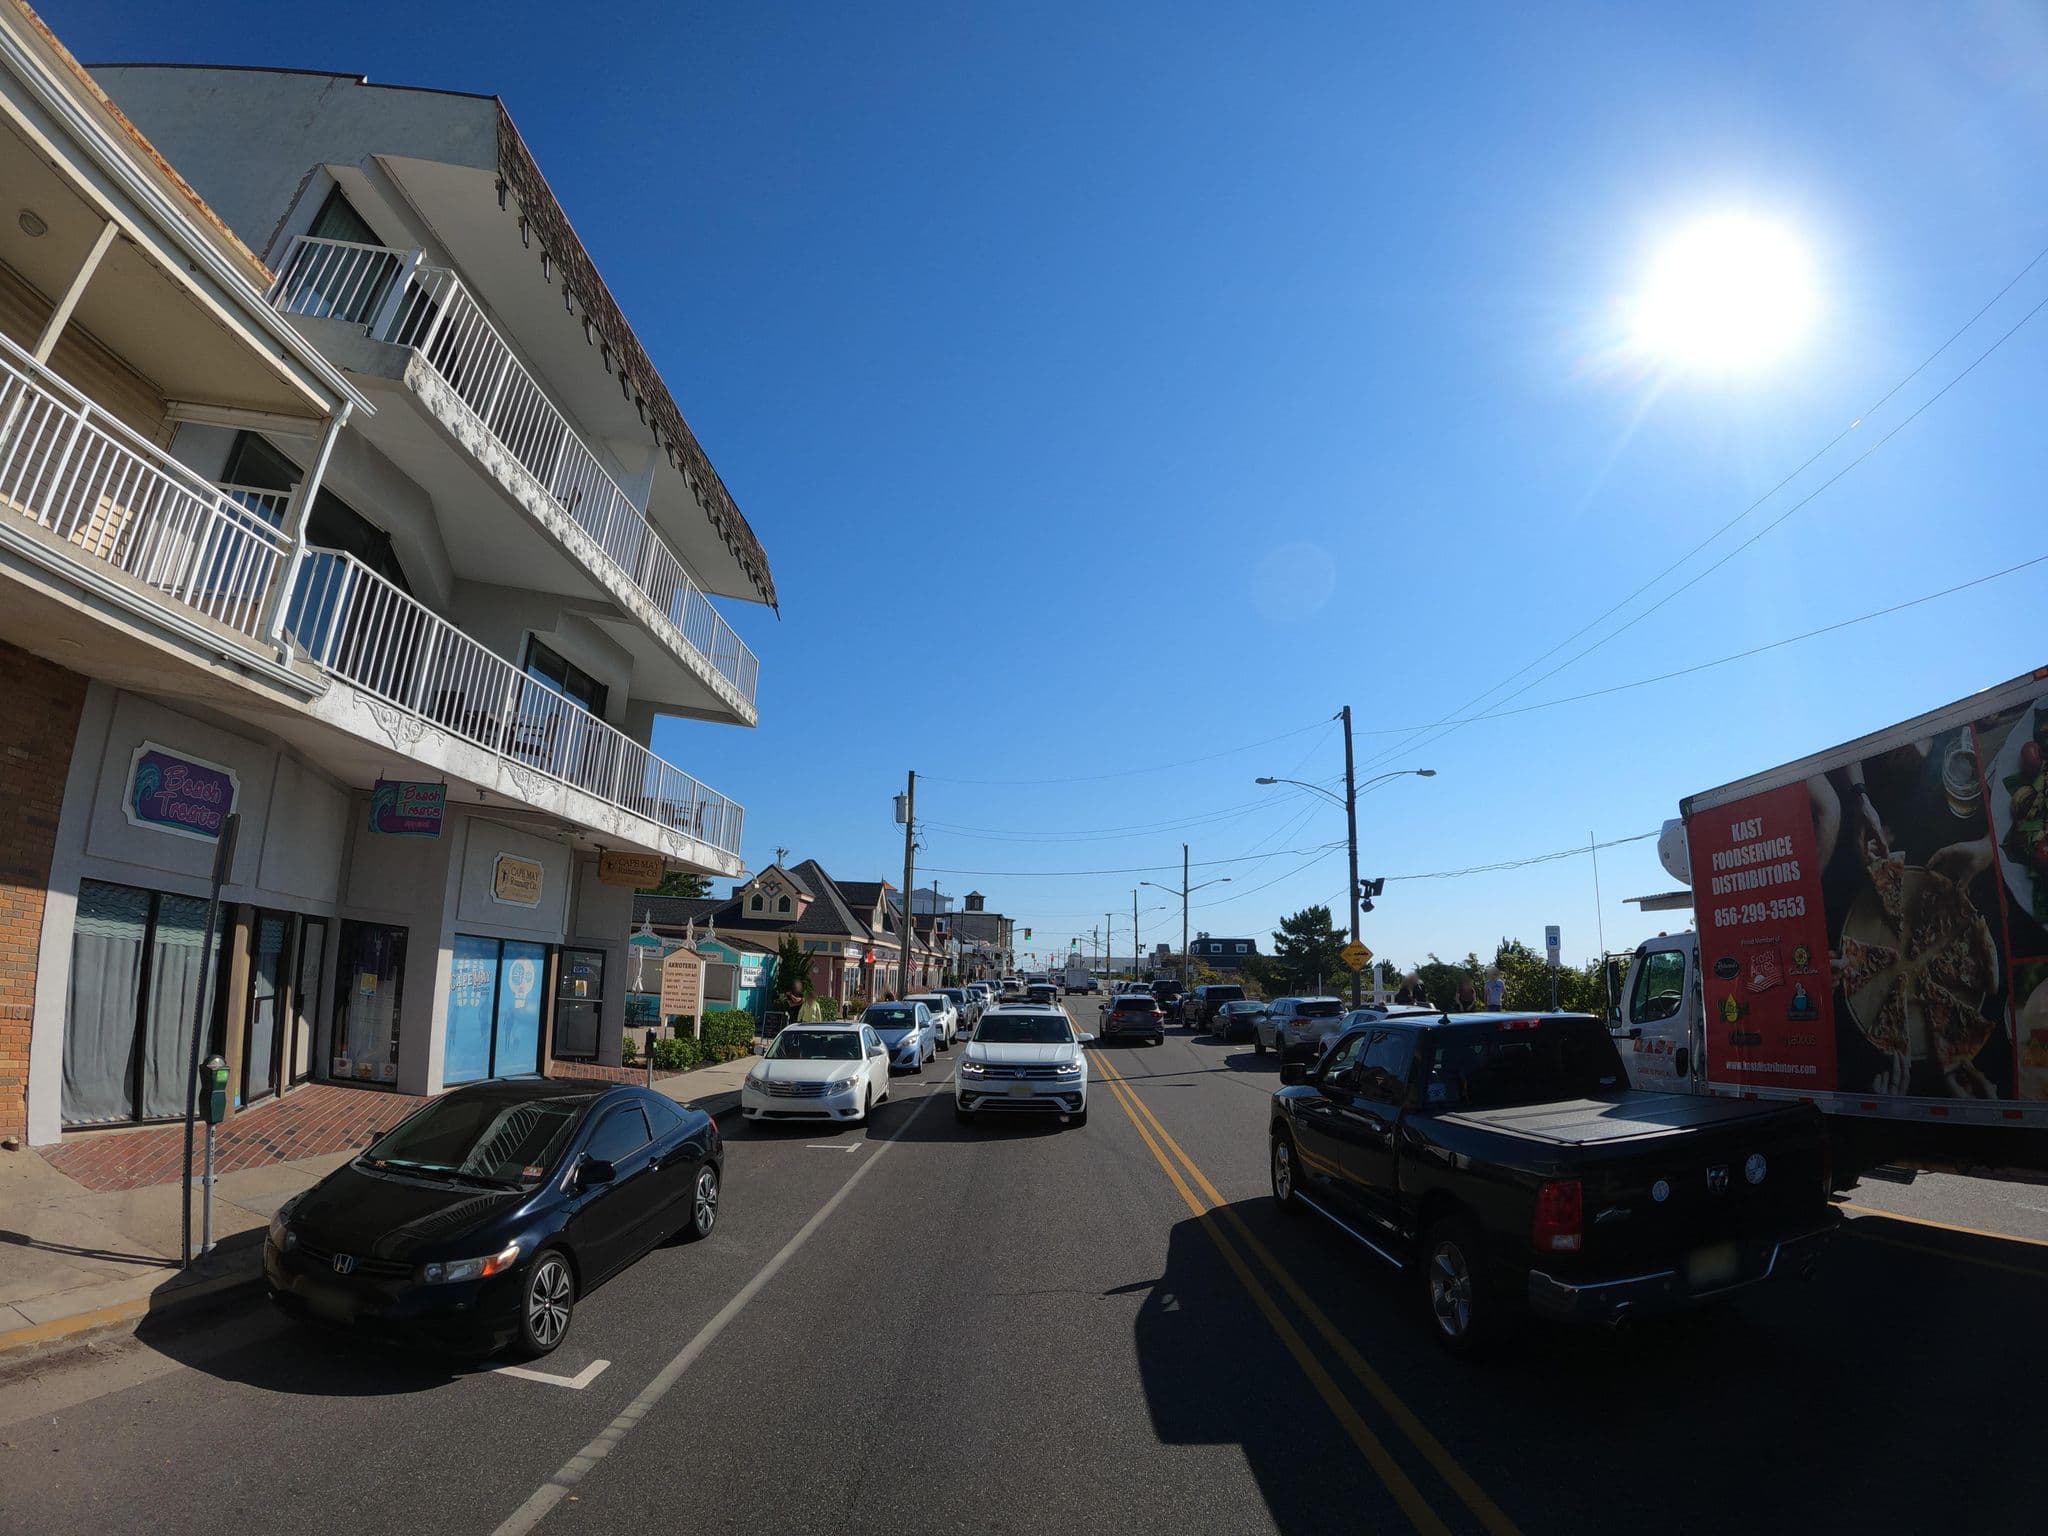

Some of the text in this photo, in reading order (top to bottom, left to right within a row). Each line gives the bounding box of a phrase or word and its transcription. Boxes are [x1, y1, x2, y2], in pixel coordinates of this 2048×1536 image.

[164, 765, 222, 804] Beach
[403, 785, 441, 802] Beach
[154, 791, 221, 829] Treats
[1731, 817, 1762, 842] KAST
[619, 858, 660, 870] CAPE MAY
[1712, 836, 1793, 871] FOODSERVICE
[510, 865, 539, 882] CAPE MAY
[1711, 860, 1801, 896] DISTRIBUTORS
[1714, 896, 1806, 928] 856-299-3553
[1726, 1060, 1817, 1075] www.kastdistributors.com
